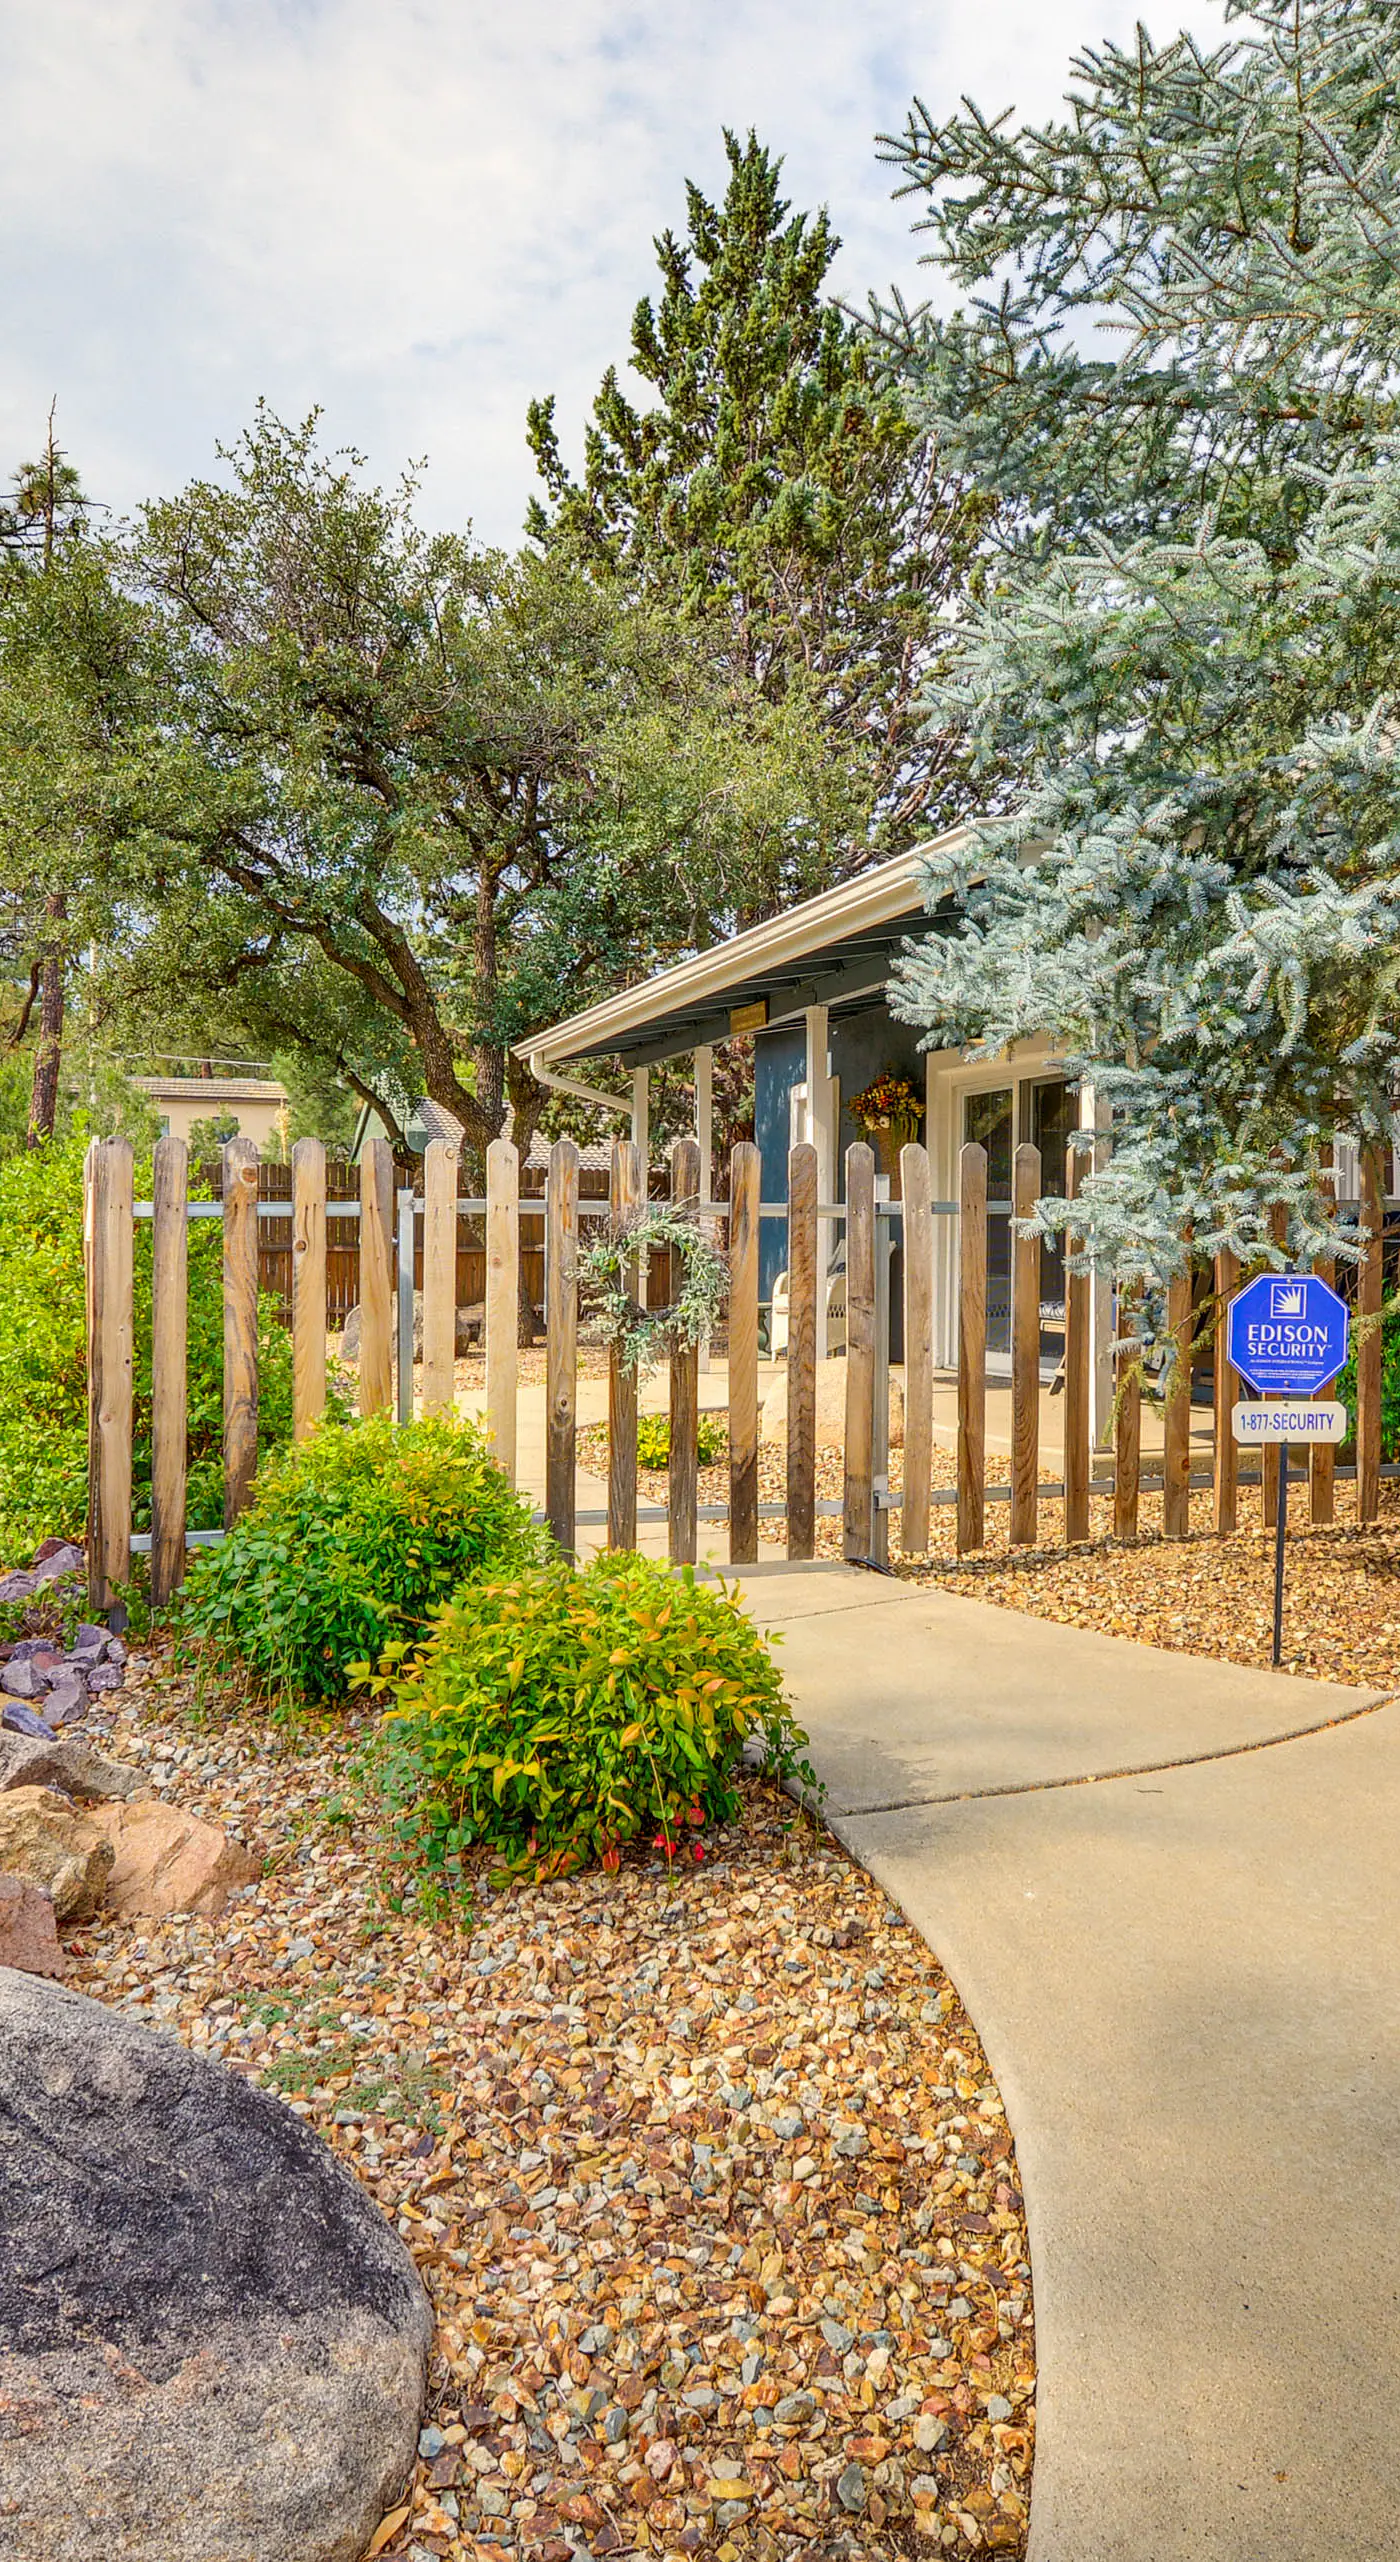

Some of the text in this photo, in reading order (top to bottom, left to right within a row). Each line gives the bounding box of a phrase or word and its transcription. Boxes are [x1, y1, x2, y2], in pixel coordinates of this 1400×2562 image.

[1248, 1325, 1328, 1343] EDISON
[1248, 1342, 1326, 1357] SECURITY
[1241, 1413, 1334, 1430] 1-877-SECURITY
